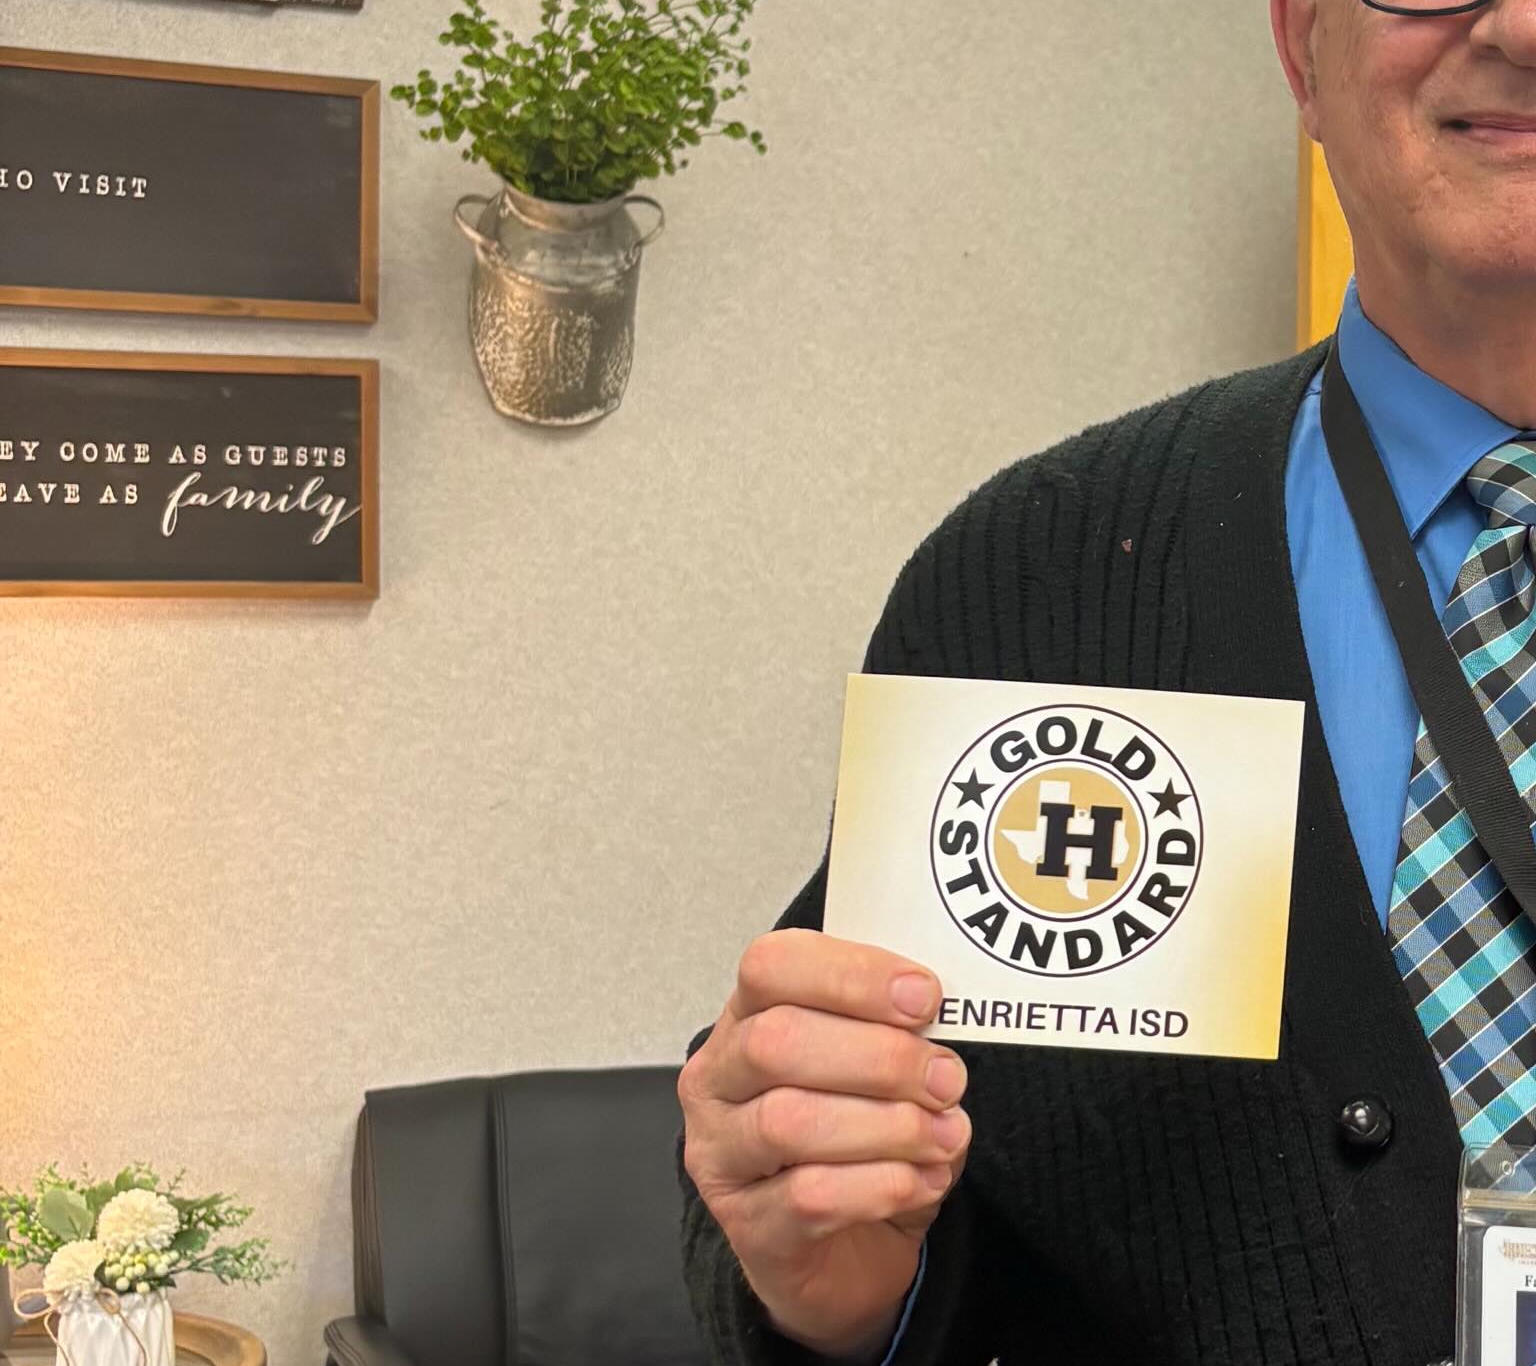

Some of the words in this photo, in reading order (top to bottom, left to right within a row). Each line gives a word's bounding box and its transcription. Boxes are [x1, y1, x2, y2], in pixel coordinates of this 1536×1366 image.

[52, 171, 147, 198] VISIT
[0, 440, 39, 461] EY
[59, 441, 150, 464] COME
[168, 444, 207, 465] AS
[224, 444, 346, 467] GUESTS
[99, 483, 138, 504] AS
[161, 471, 363, 546] family
[990, 716, 1157, 782] GOLD
[1036, 802, 1124, 881] H
[939, 818, 1197, 971] STANDARD
[931, 997, 1120, 1035] ENRIETTA
[1129, 1008, 1189, 1038] ISD
